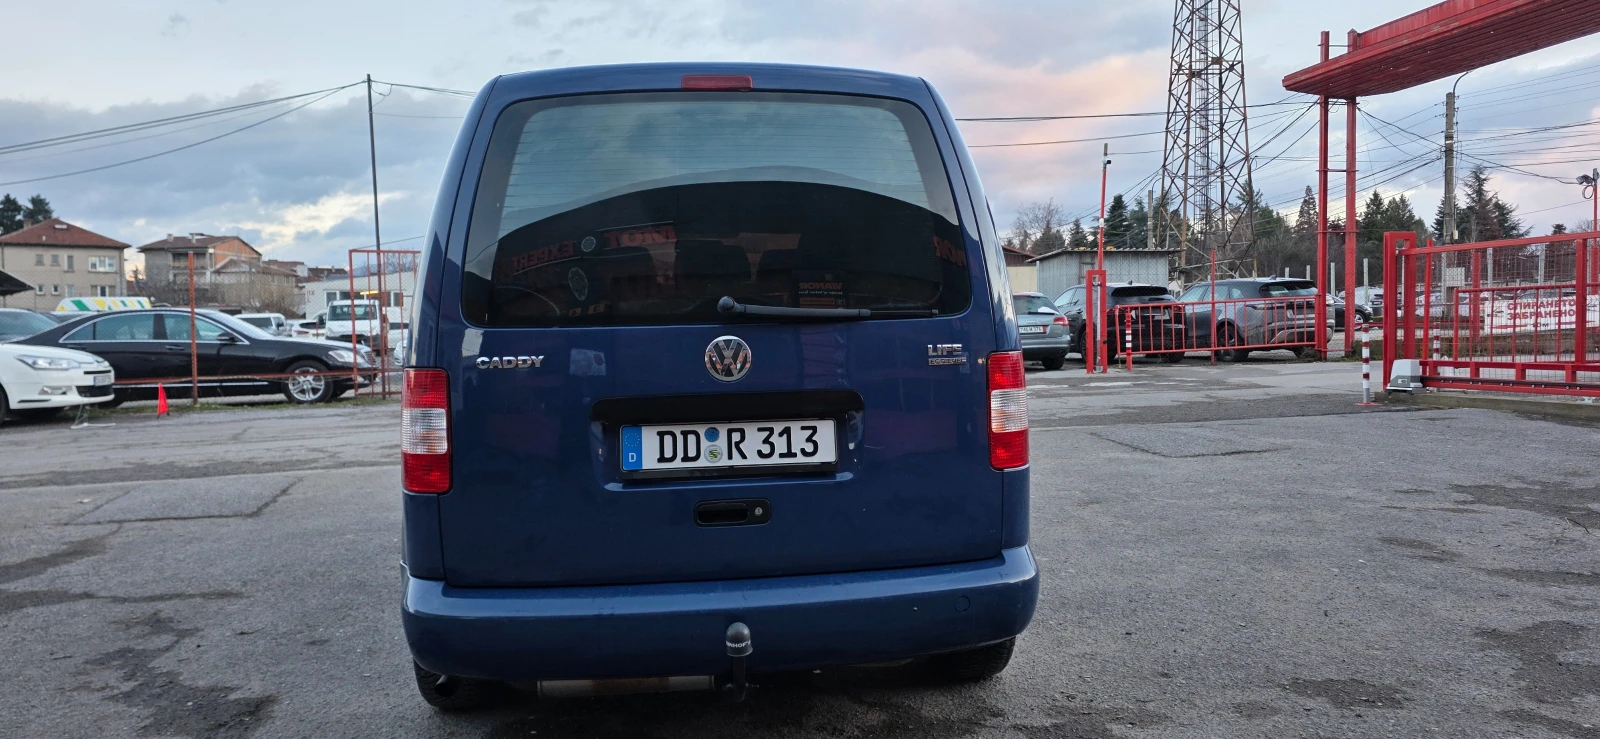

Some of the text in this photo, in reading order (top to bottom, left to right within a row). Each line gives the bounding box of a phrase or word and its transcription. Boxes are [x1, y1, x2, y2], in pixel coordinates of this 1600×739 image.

[927, 344, 962, 356] LIFE
[475, 355, 545, 369] CADDY
[656, 426, 819, 463] DD R 313
[628, 453, 637, 462] D
